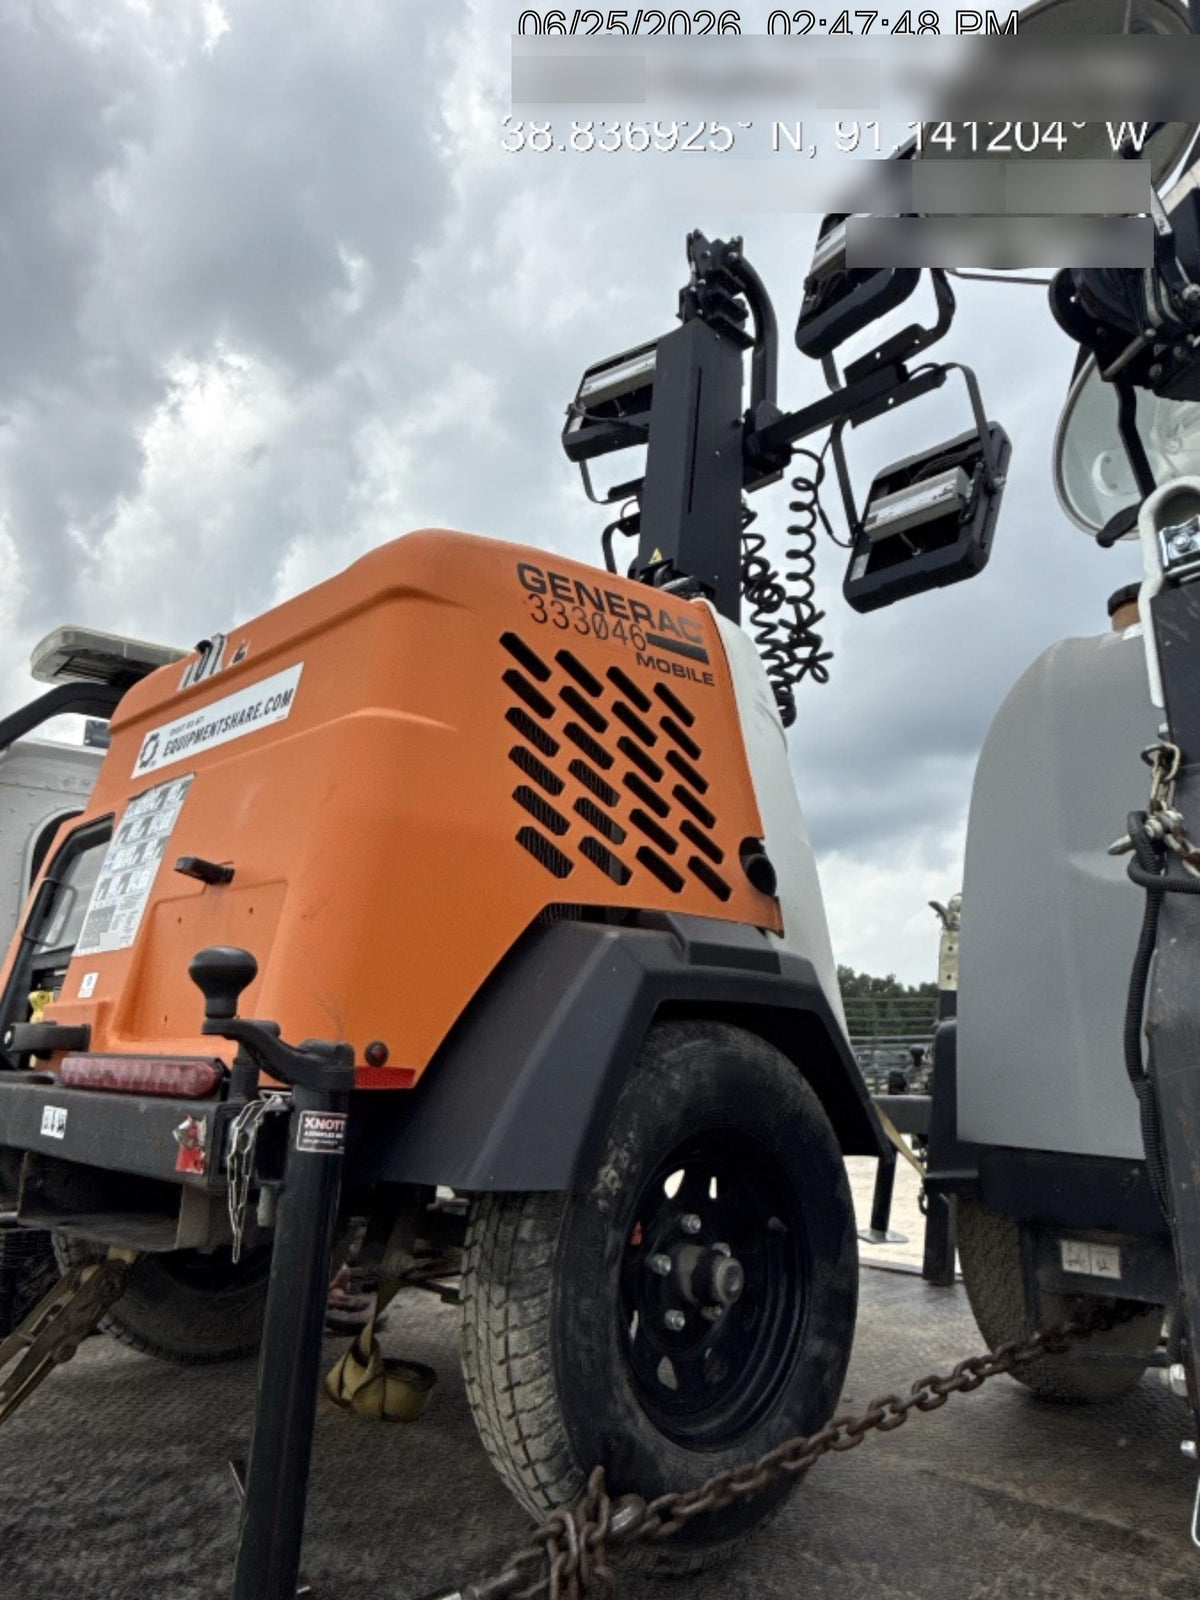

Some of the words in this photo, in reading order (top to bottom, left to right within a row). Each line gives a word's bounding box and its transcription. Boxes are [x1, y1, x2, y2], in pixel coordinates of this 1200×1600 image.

[516, 562, 704, 644] GENERAC
[528, 593, 647, 652] 333046
[636, 652, 716, 687] MOBILE
[163, 687, 294, 757] EQUIPMENTSHARE.COM
